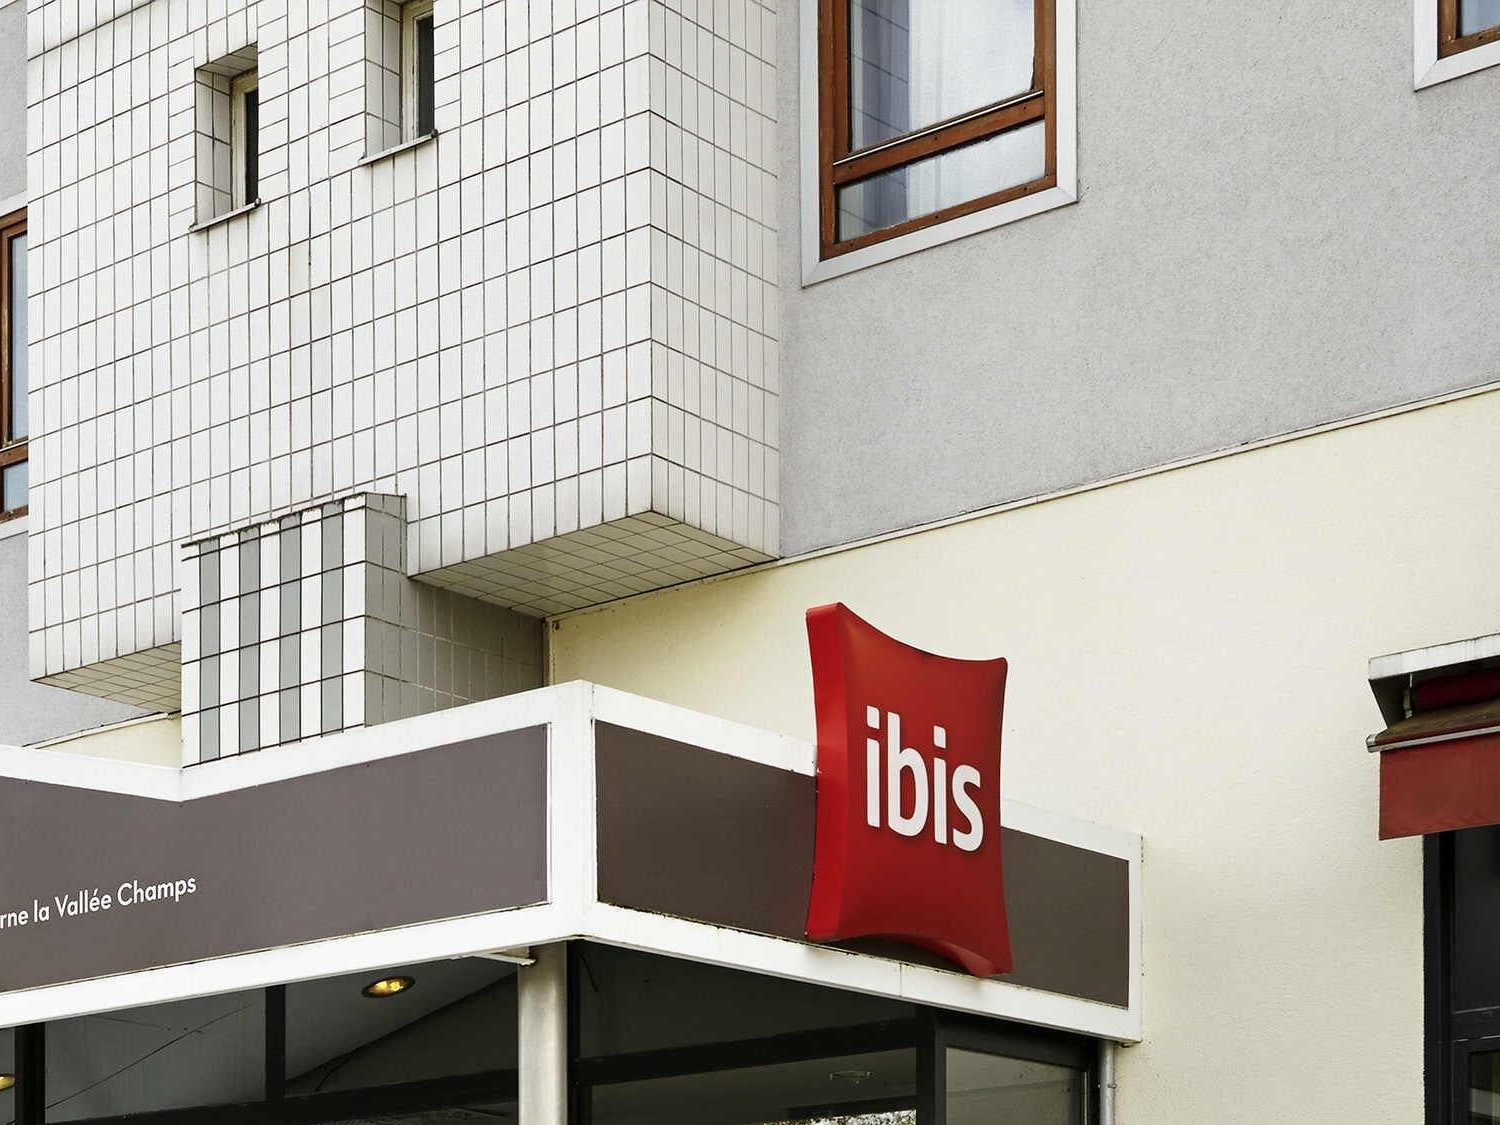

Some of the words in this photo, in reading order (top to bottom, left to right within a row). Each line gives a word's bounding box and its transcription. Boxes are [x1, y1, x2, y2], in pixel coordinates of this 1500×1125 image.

[866, 705, 984, 852] ibis
[33, 899, 50, 922] la
[54, 888, 112, 918] Vallée
[117, 877, 197, 906] Champs
